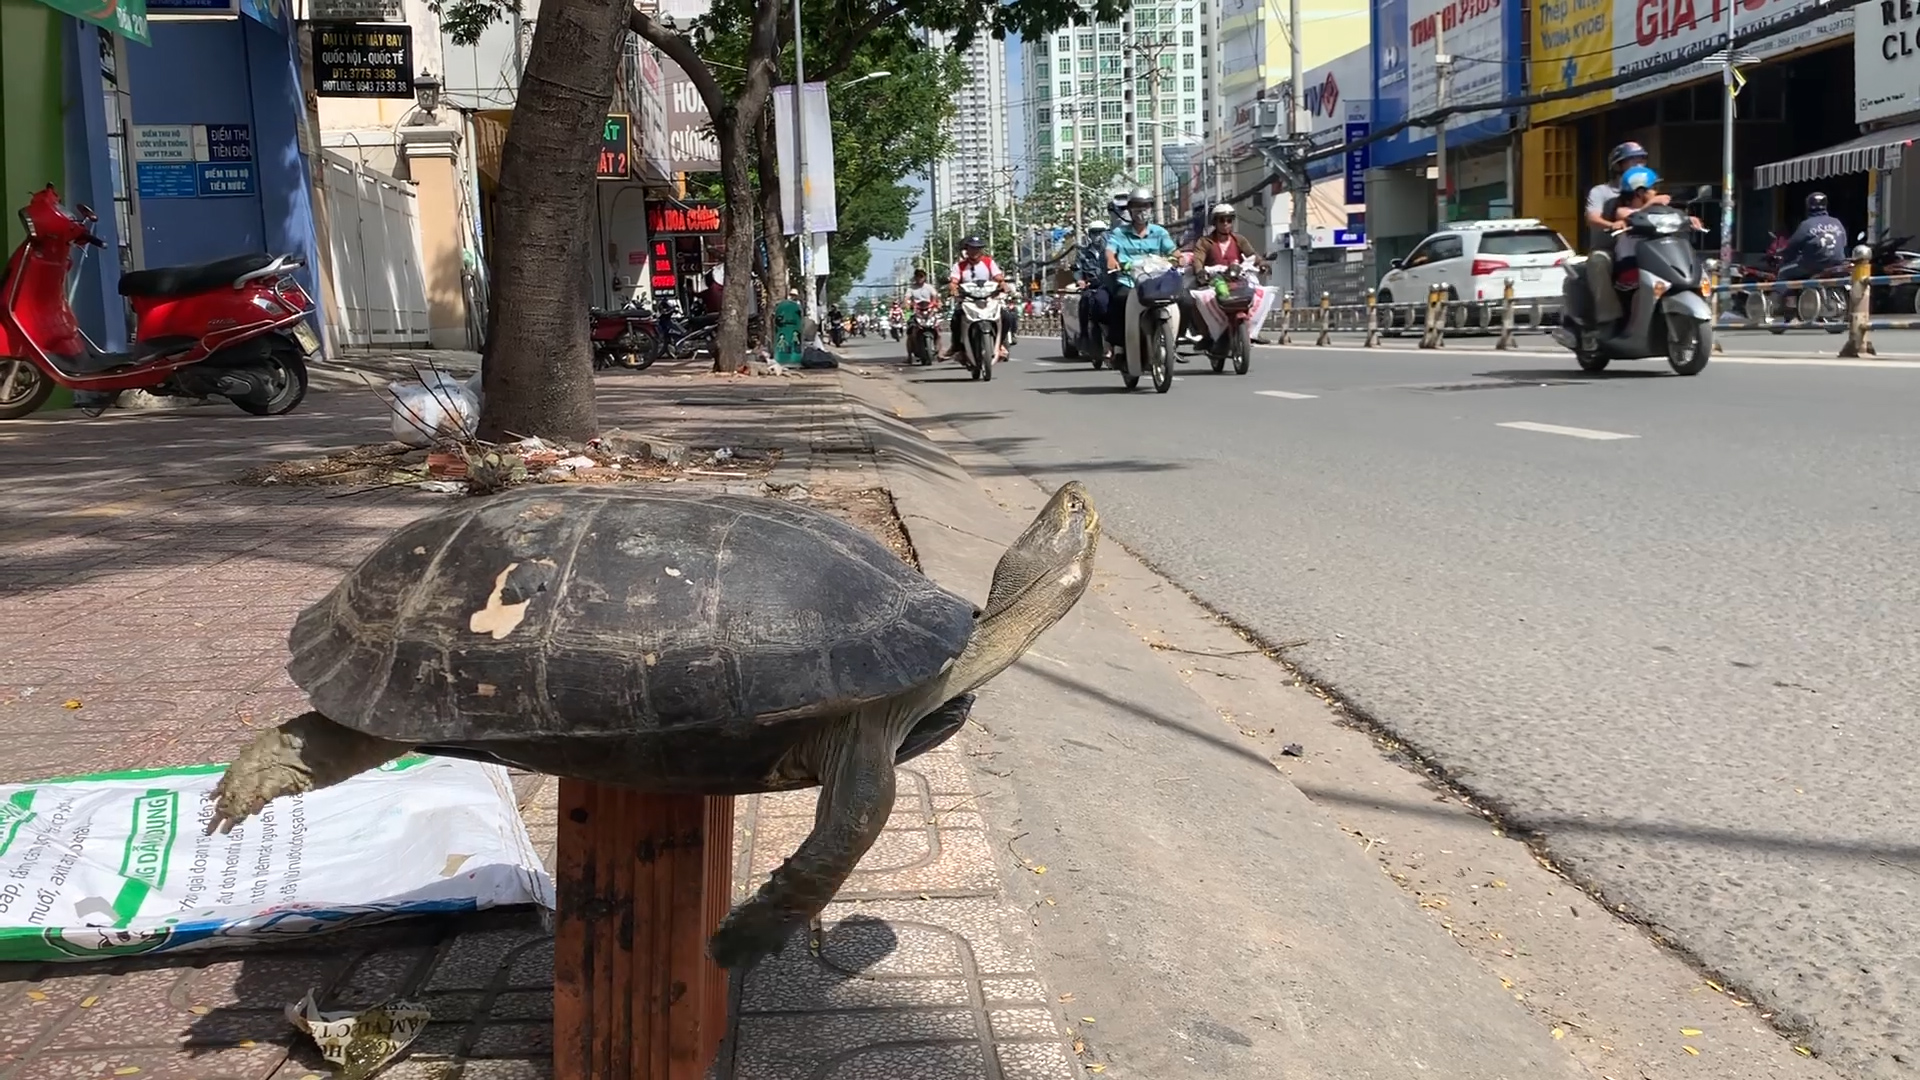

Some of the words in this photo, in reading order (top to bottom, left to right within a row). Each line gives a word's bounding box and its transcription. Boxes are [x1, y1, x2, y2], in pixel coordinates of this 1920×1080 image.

[1882, 0, 1920, 26] RE
[386, 34, 403, 47] BAY
[1882, 28, 1920, 62] CL
[322, 48, 345, 65] QUỐC
[346, 49, 362, 66] NỘI
[368, 48, 391, 66] QUỐC
[392, 48, 405, 65] TẾ
[349, 68, 372, 79] 3775
[322, 80, 355, 92] HOTLINE:
[375, 81, 386, 92] 75
[211, 126, 232, 142] ĐIỂM
[234, 129, 250, 141] THU
[618, 152, 626, 173] 2
[28, 887, 61, 925] muối,
